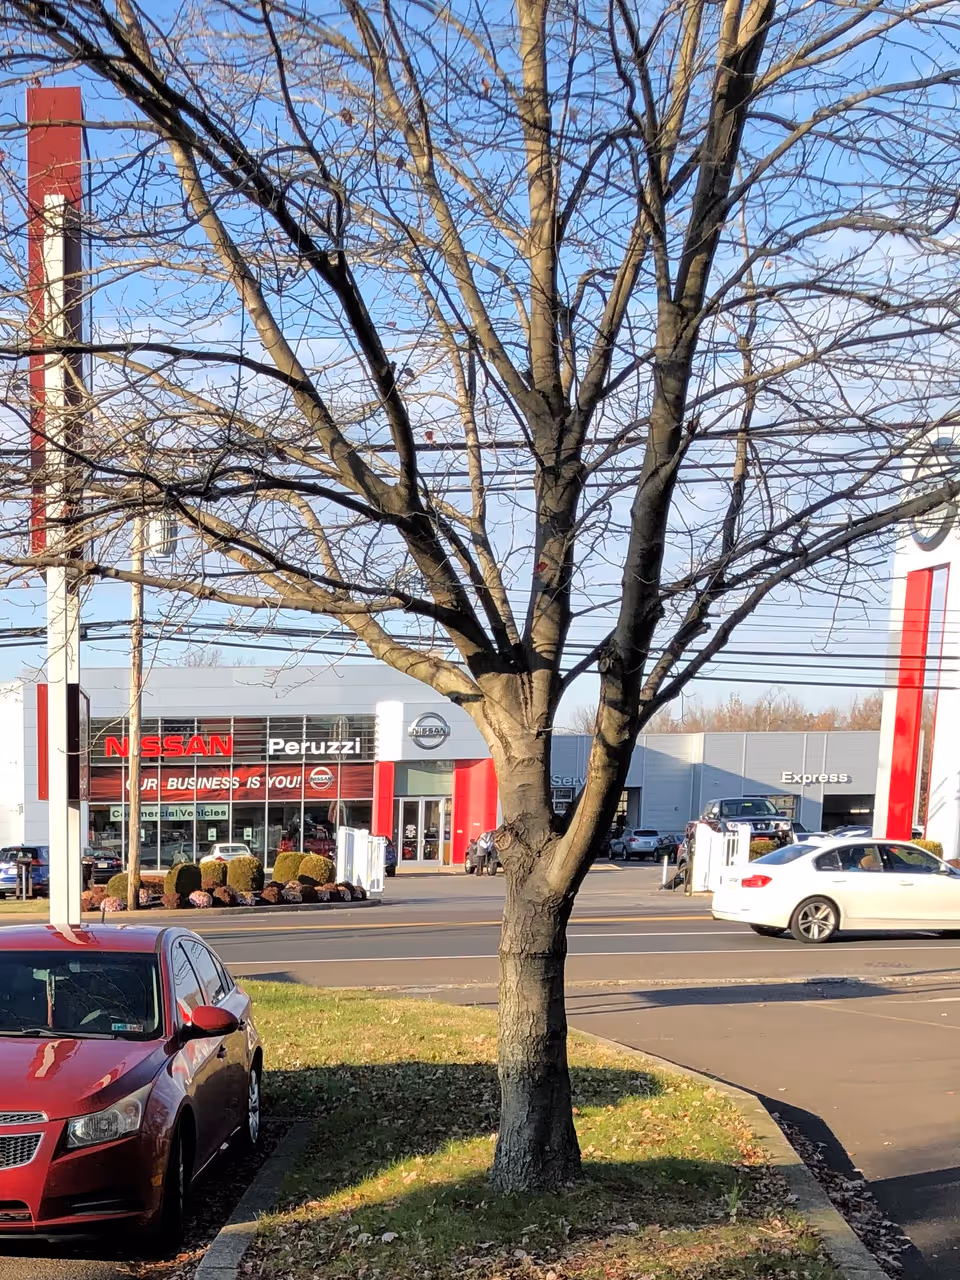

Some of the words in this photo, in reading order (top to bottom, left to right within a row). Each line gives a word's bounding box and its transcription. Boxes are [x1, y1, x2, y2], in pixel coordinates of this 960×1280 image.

[413, 727, 447, 735] NISSAN
[105, 735, 233, 757] NSSAN
[268, 738, 361, 755] Peruzzi
[167, 776, 239, 790] BUSINESS
[246, 775, 260, 788] IS
[267, 775, 302, 789] YOU!
[551, 774, 587, 786] Serv
[781, 771, 848, 786] Express
[112, 809, 178, 819] Comercial
[180, 808, 227, 818] Vehicles
